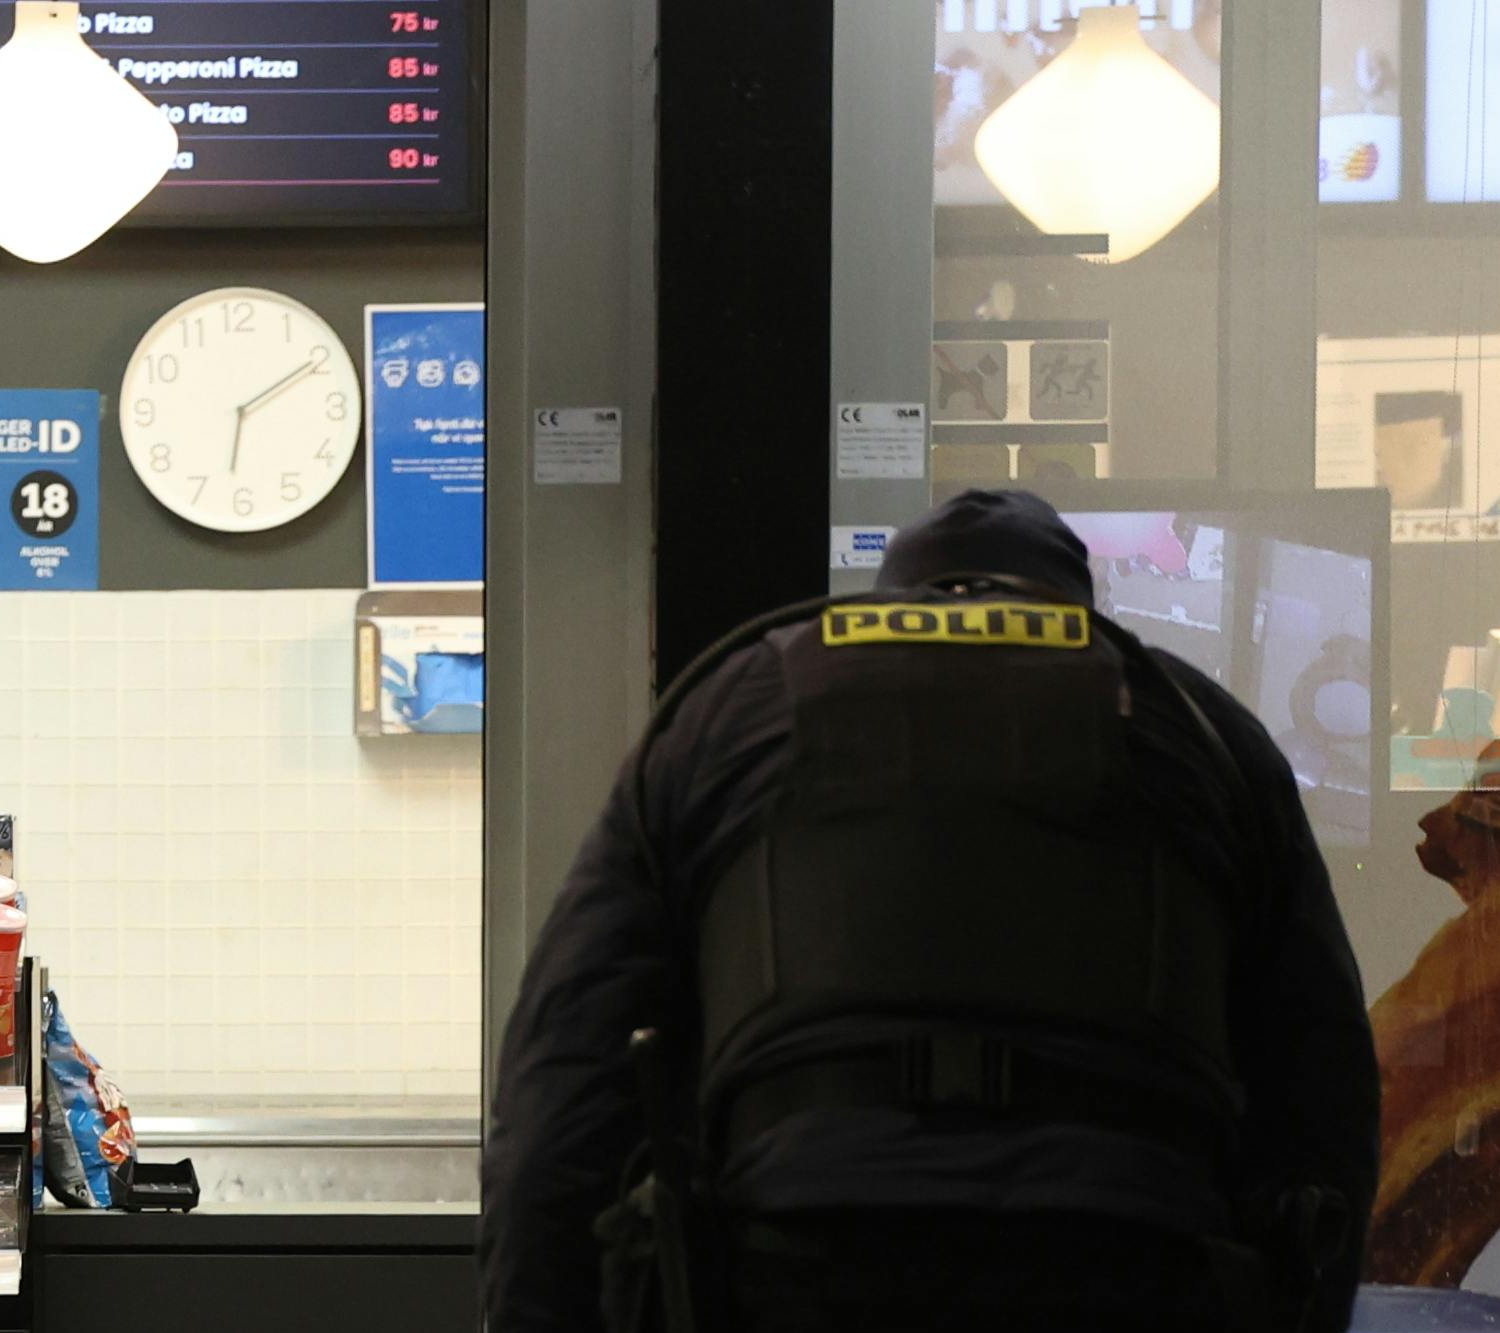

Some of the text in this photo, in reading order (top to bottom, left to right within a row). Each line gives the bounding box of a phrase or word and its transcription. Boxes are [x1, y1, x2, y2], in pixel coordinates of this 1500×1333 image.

[94, 13, 154, 35] Pizza
[390, 12, 419, 33] 75
[118, 57, 298, 85] Pepperoni Pizza
[388, 58, 419, 78] 85
[188, 102, 247, 125] Pizza
[388, 104, 419, 123] 85
[388, 149, 419, 168] 90
[178, 315, 205, 349] 11
[220, 300, 256, 334] 12
[281, 311, 293, 344] 1
[144, 352, 180, 385] 10
[308, 344, 331, 376] 2
[133, 397, 156, 429] 9
[325, 390, 348, 422] 3
[149, 442, 172, 474] 8
[313, 437, 336, 468] 4
[20, 481, 70, 519] 18
[186, 474, 210, 507] 7
[232, 486, 255, 518] 6
[279, 471, 302, 502] 5
[829, 607, 1086, 642] POLITI
